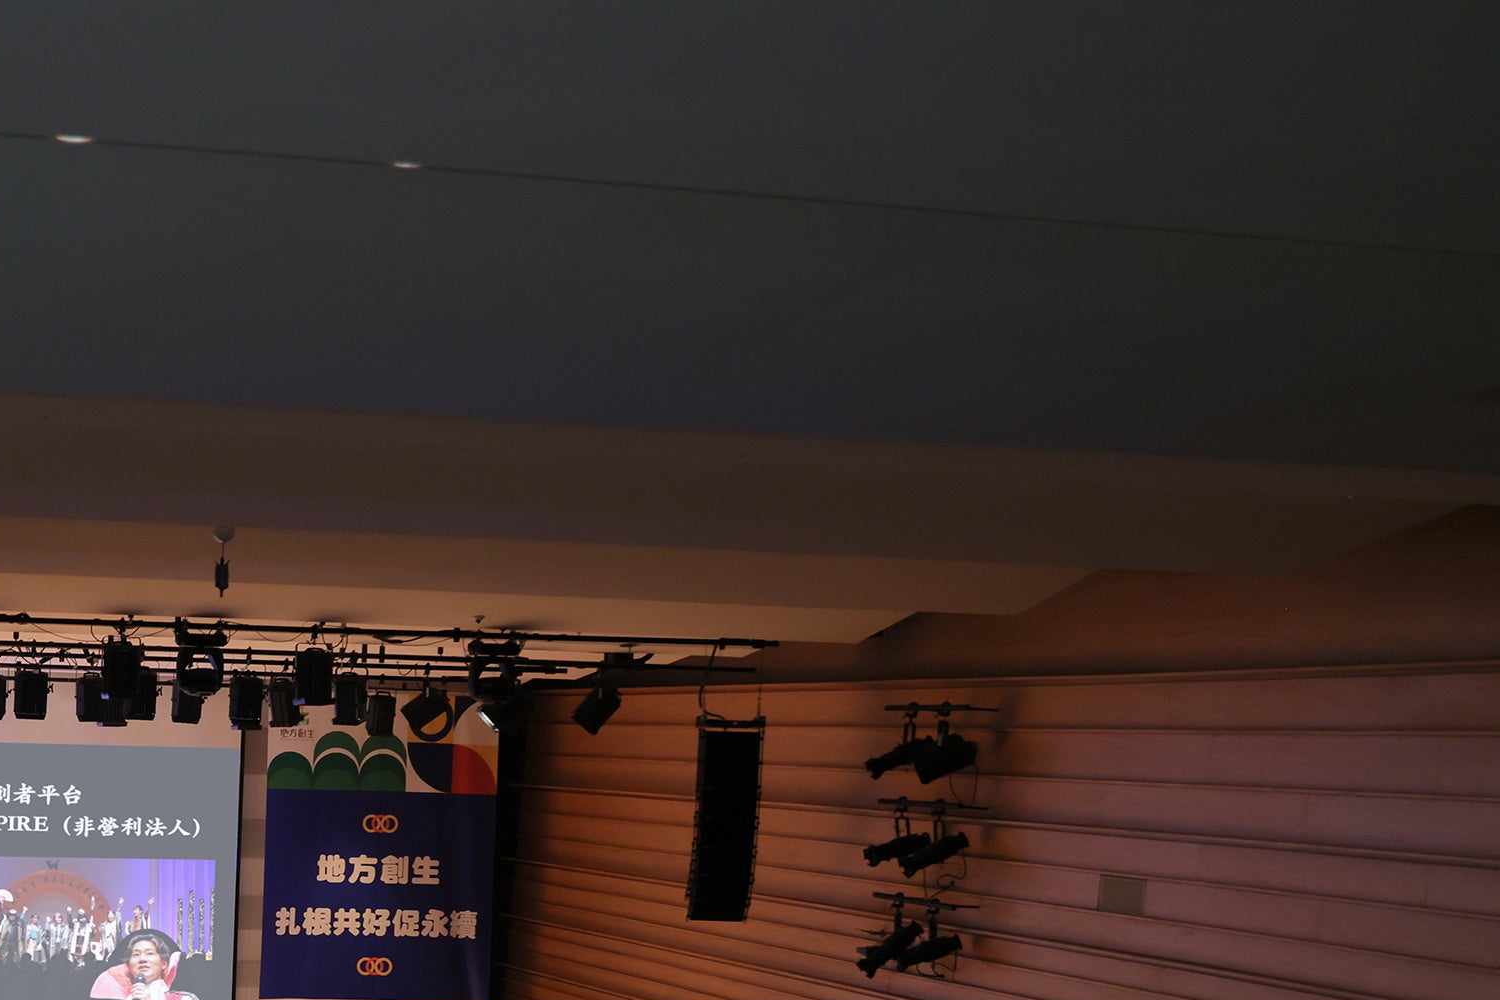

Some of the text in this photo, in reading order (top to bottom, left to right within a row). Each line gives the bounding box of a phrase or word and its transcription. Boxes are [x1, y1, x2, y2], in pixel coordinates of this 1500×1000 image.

[316, 854, 440, 885] 地方創生
[275, 907, 478, 940] 扎根共好促永續
